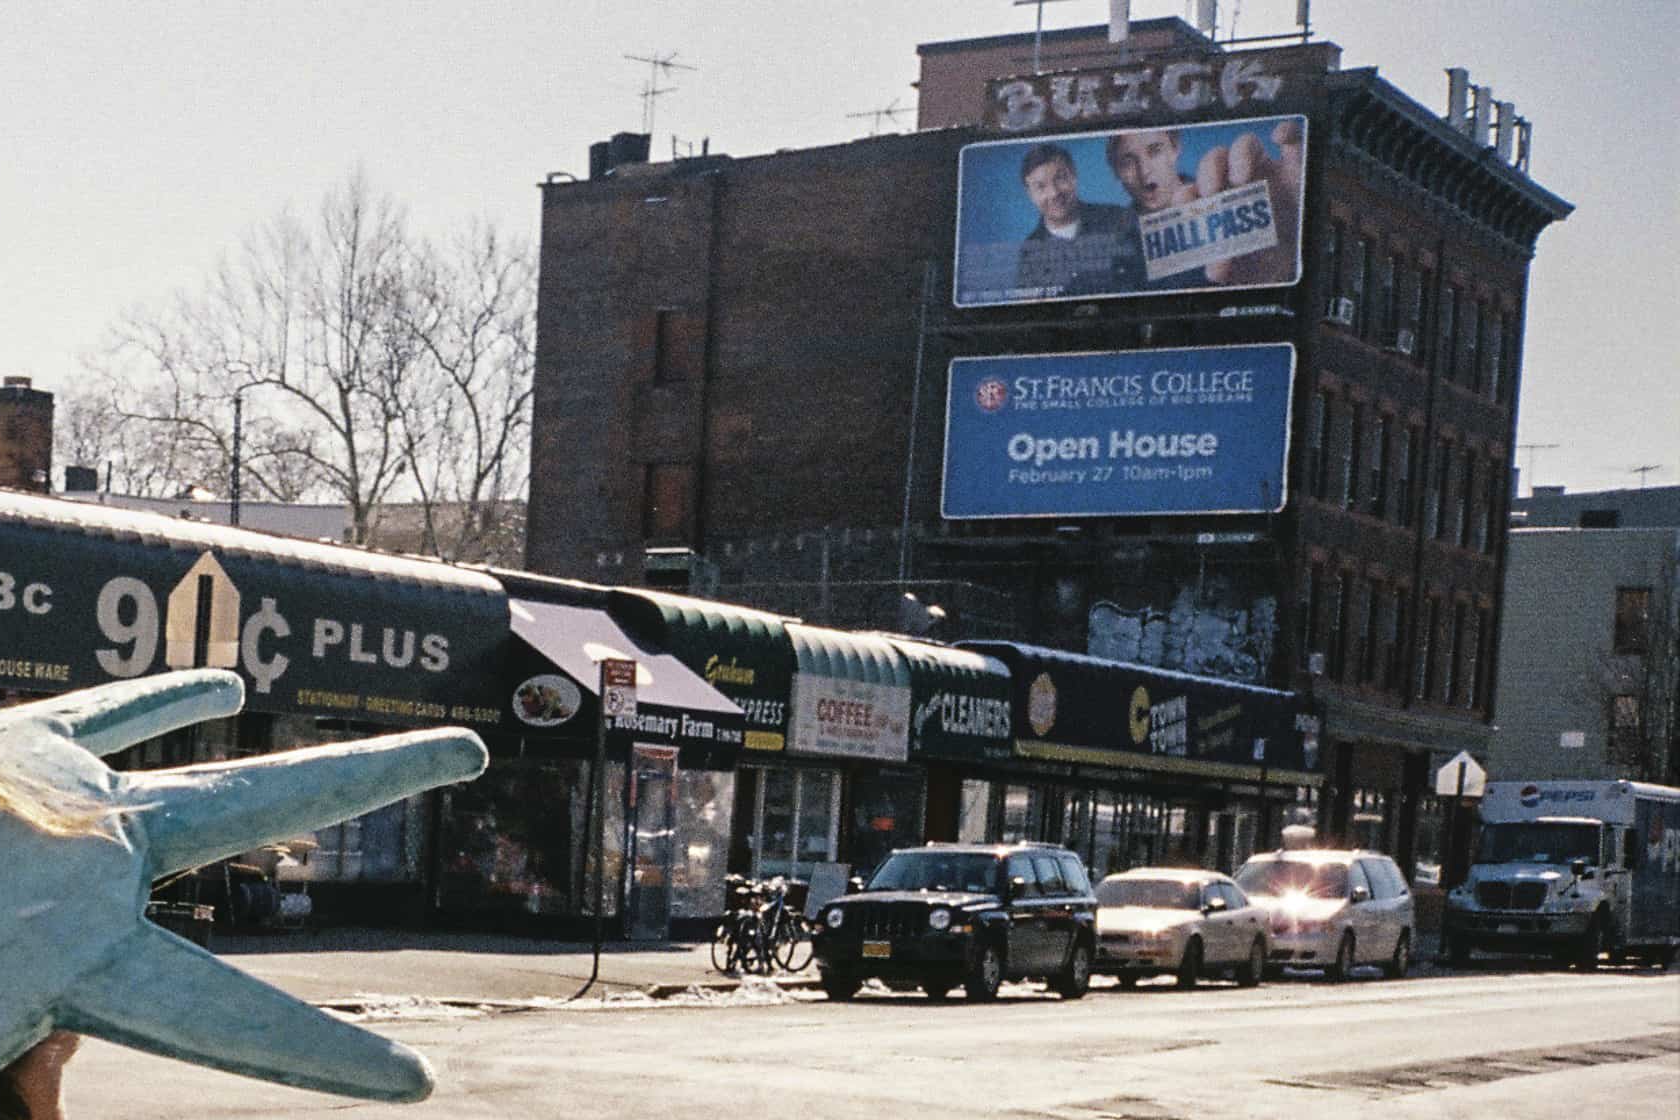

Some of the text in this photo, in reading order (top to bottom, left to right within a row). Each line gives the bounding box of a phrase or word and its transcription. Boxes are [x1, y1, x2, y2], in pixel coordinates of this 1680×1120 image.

[998, 58, 1283, 131] BUICK
[1145, 220, 1205, 261] HALL
[1207, 198, 1271, 243] PASS
[1046, 374, 1143, 399] FRANCIS
[1150, 370, 1254, 396] COLLEGE
[1007, 429, 1219, 466] Open House
[1007, 466, 1086, 484] February
[1092, 466, 1113, 481] 27
[95, 575, 292, 694] 9¢
[312, 617, 451, 672] PLUS
[34, 662, 71, 682] WARE
[681, 713, 714, 738] Farm
[816, 697, 873, 728] COFFEE
[940, 692, 1011, 739] CLEANERS
[1539, 789, 1597, 802] PEPSI
